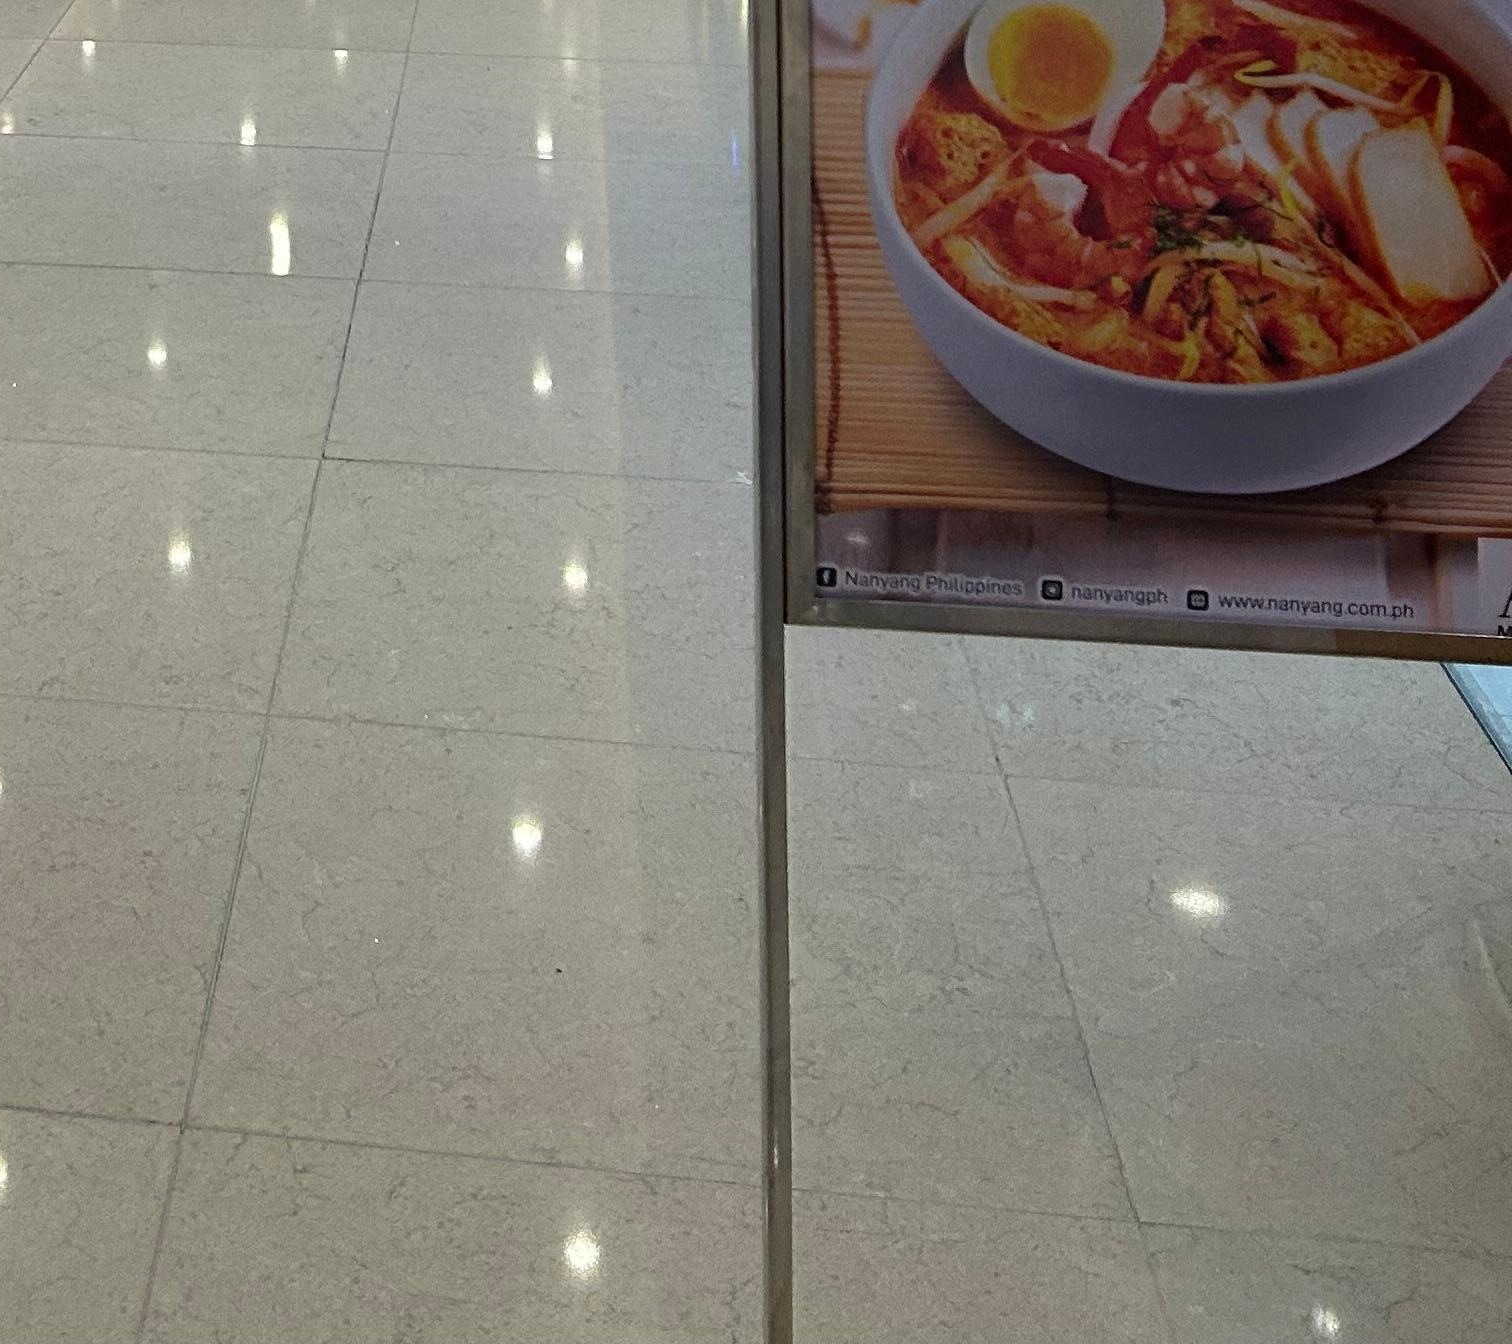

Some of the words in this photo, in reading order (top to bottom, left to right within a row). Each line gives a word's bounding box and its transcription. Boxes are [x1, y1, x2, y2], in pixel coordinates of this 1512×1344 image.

[844, 570, 920, 593] Nanyang
[925, 574, 1024, 597] Philippines
[1071, 585, 1169, 607] nanyangph
[1218, 593, 1415, 619] www.nanyang.com.ph
